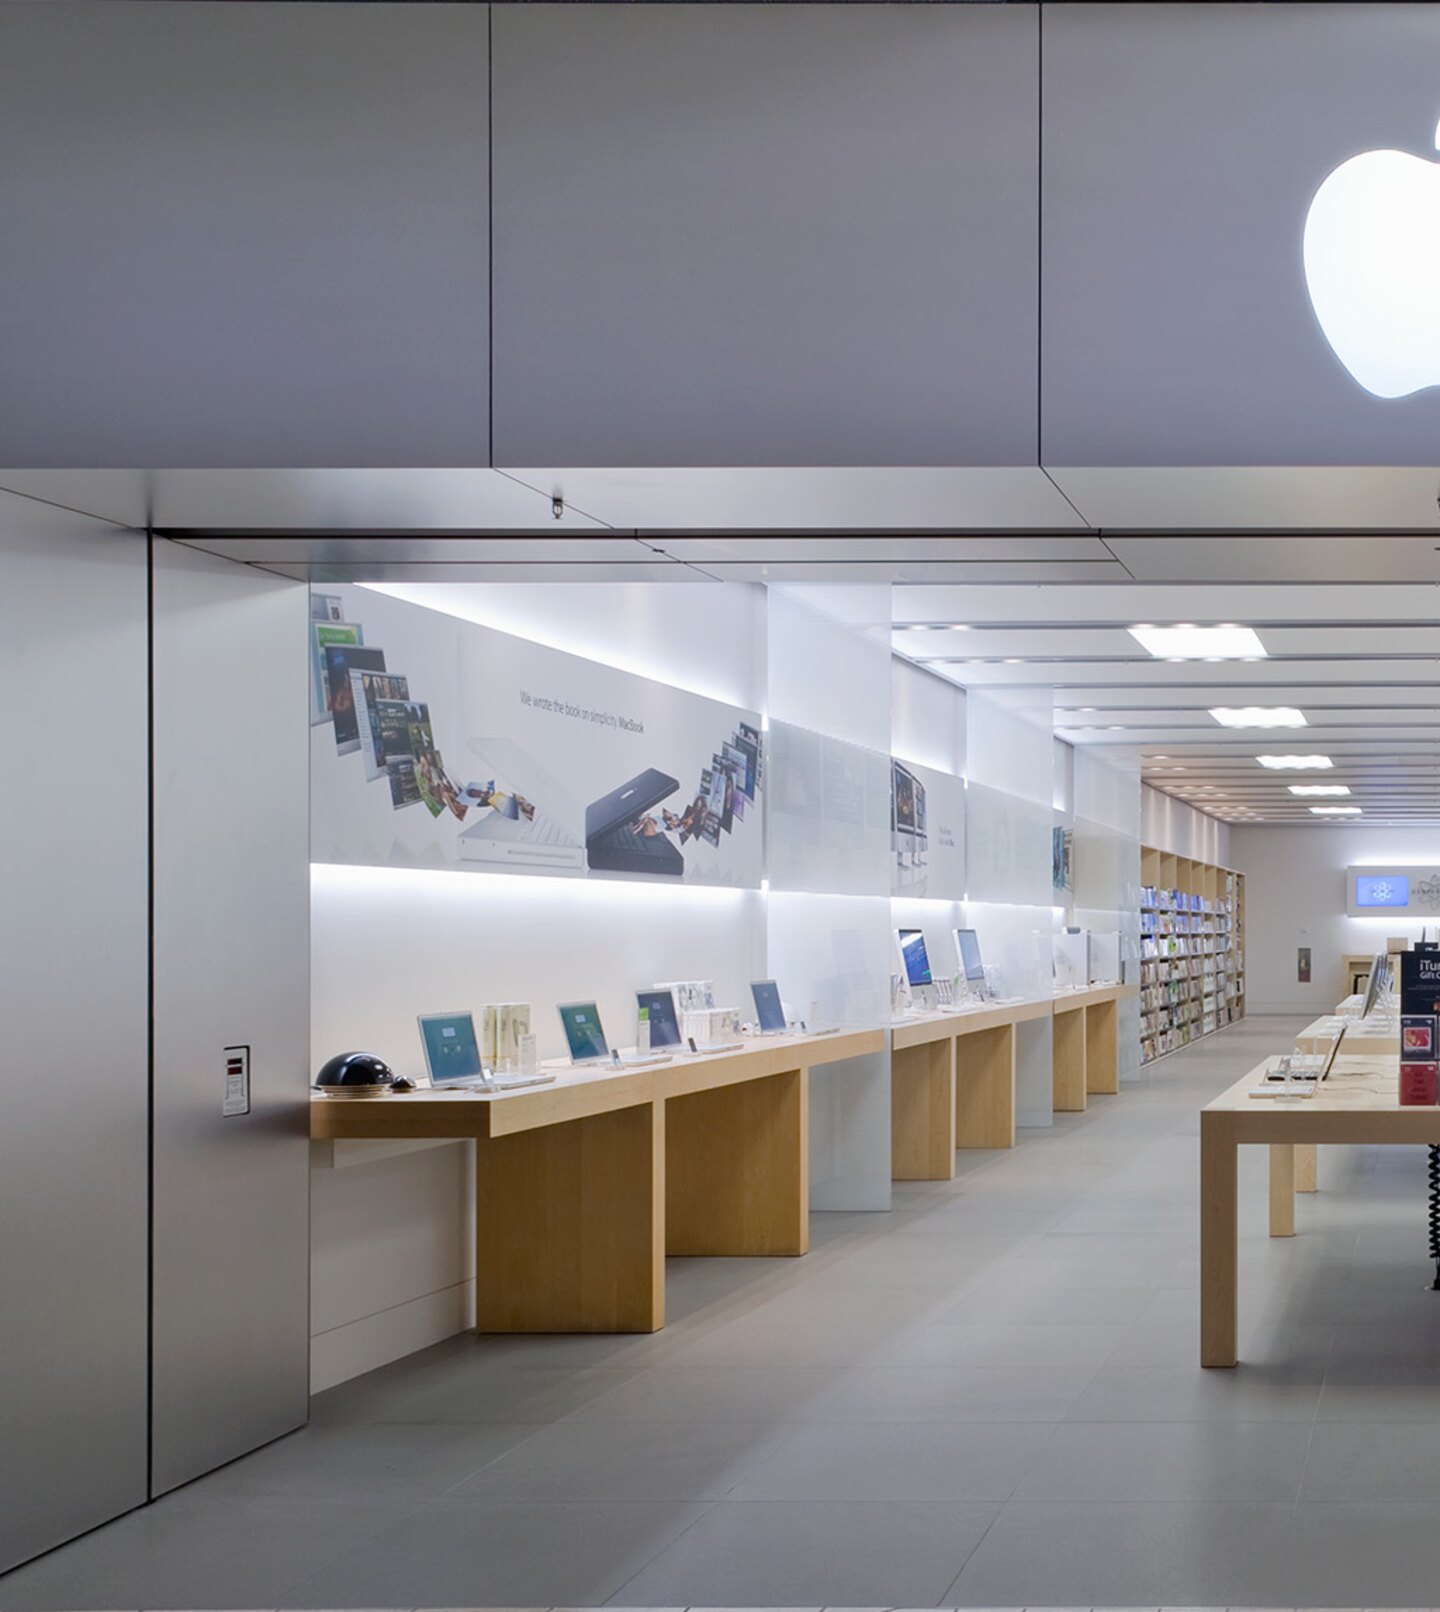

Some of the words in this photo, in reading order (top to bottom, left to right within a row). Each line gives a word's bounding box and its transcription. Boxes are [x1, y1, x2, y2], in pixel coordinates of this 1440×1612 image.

[520, 689, 532, 706] We
[533, 697, 552, 711] wrote
[553, 699, 564, 714] the
[565, 701, 580, 718] book
[582, 708, 590, 720] on
[619, 716, 644, 733] MacBook
